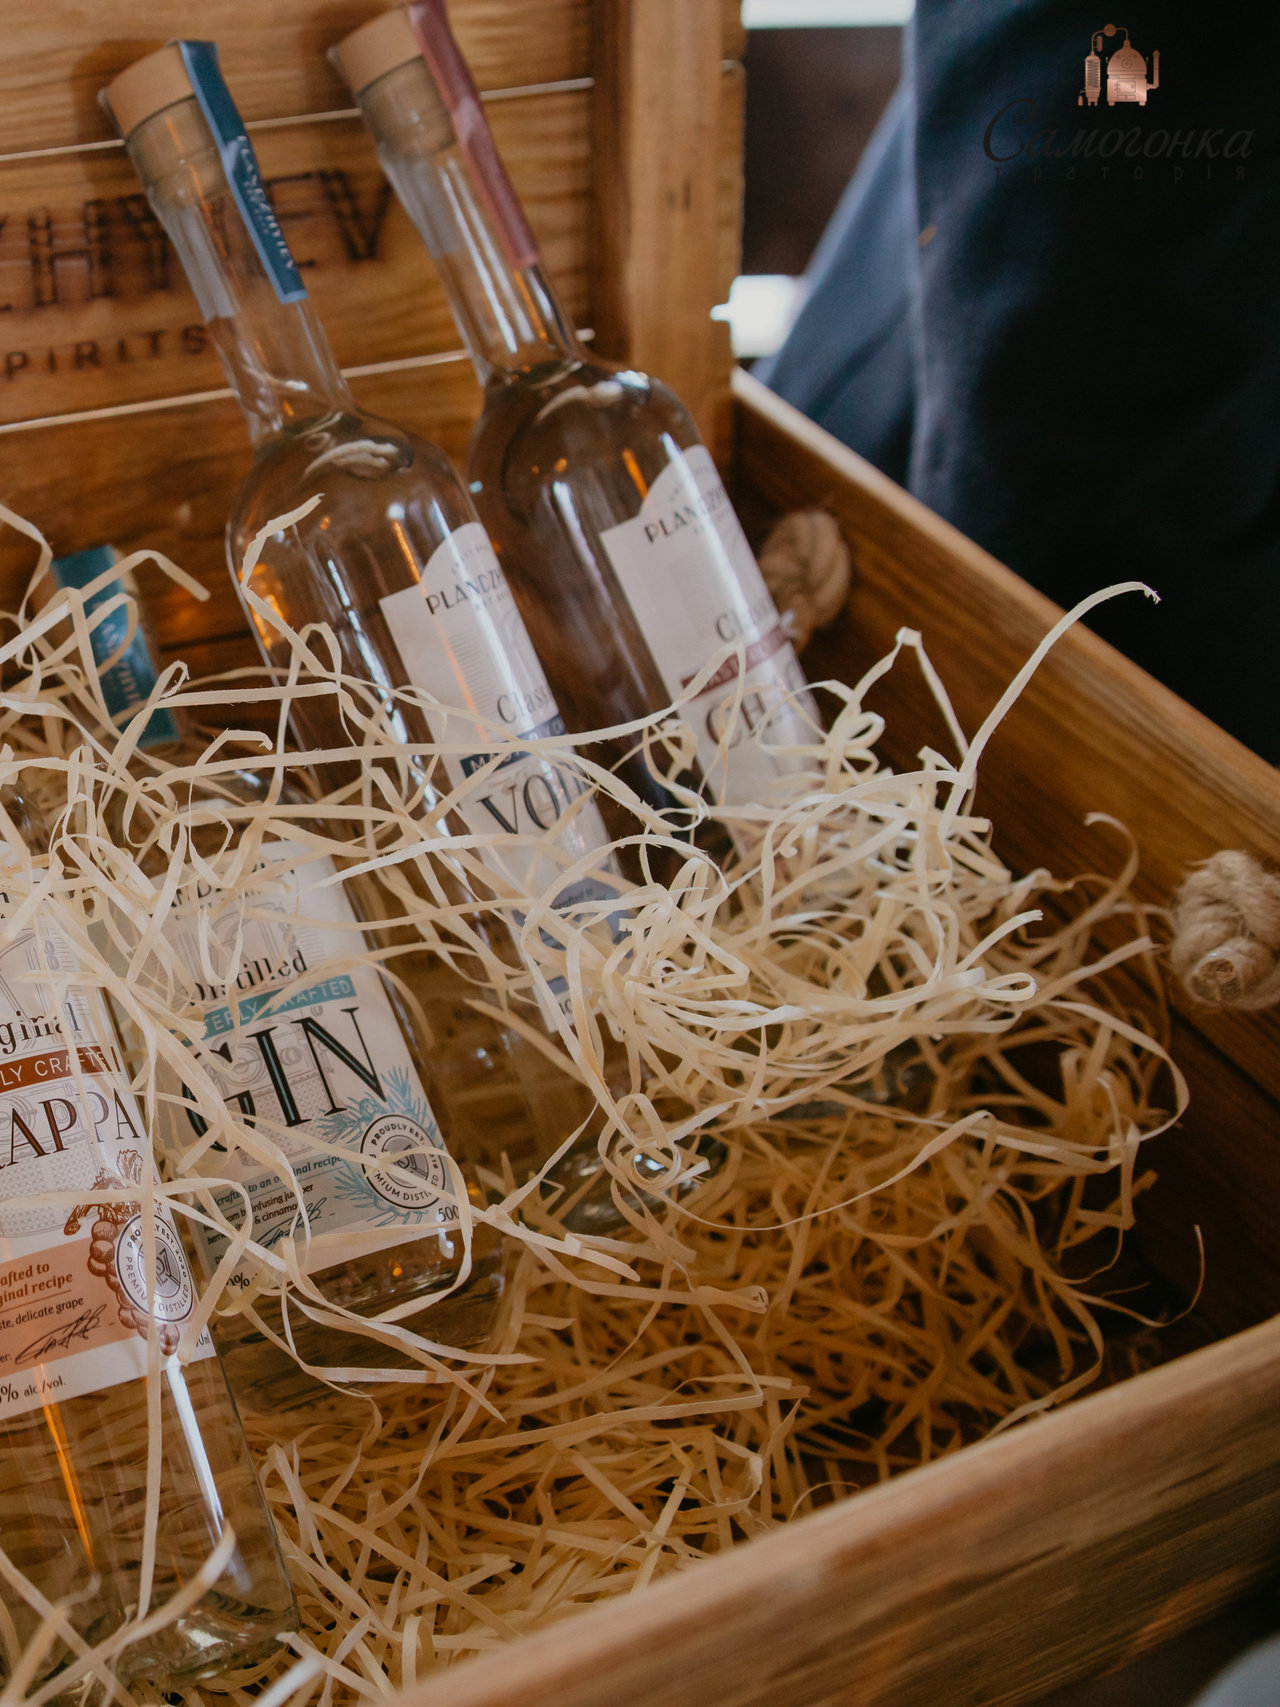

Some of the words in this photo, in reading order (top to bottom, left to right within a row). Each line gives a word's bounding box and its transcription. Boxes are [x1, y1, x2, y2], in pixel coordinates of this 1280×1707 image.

[182, 1007, 387, 1152] GIN
[371, 1123, 407, 1146] PROUDLY
[260, 1178, 272, 1189] an
[254, 1215, 262, 1225] &
[36, 1263, 50, 1275] to
[31, 1273, 73, 1294] recipe
[15, 1304, 54, 1325] delicate
[55, 1297, 84, 1315] grape
